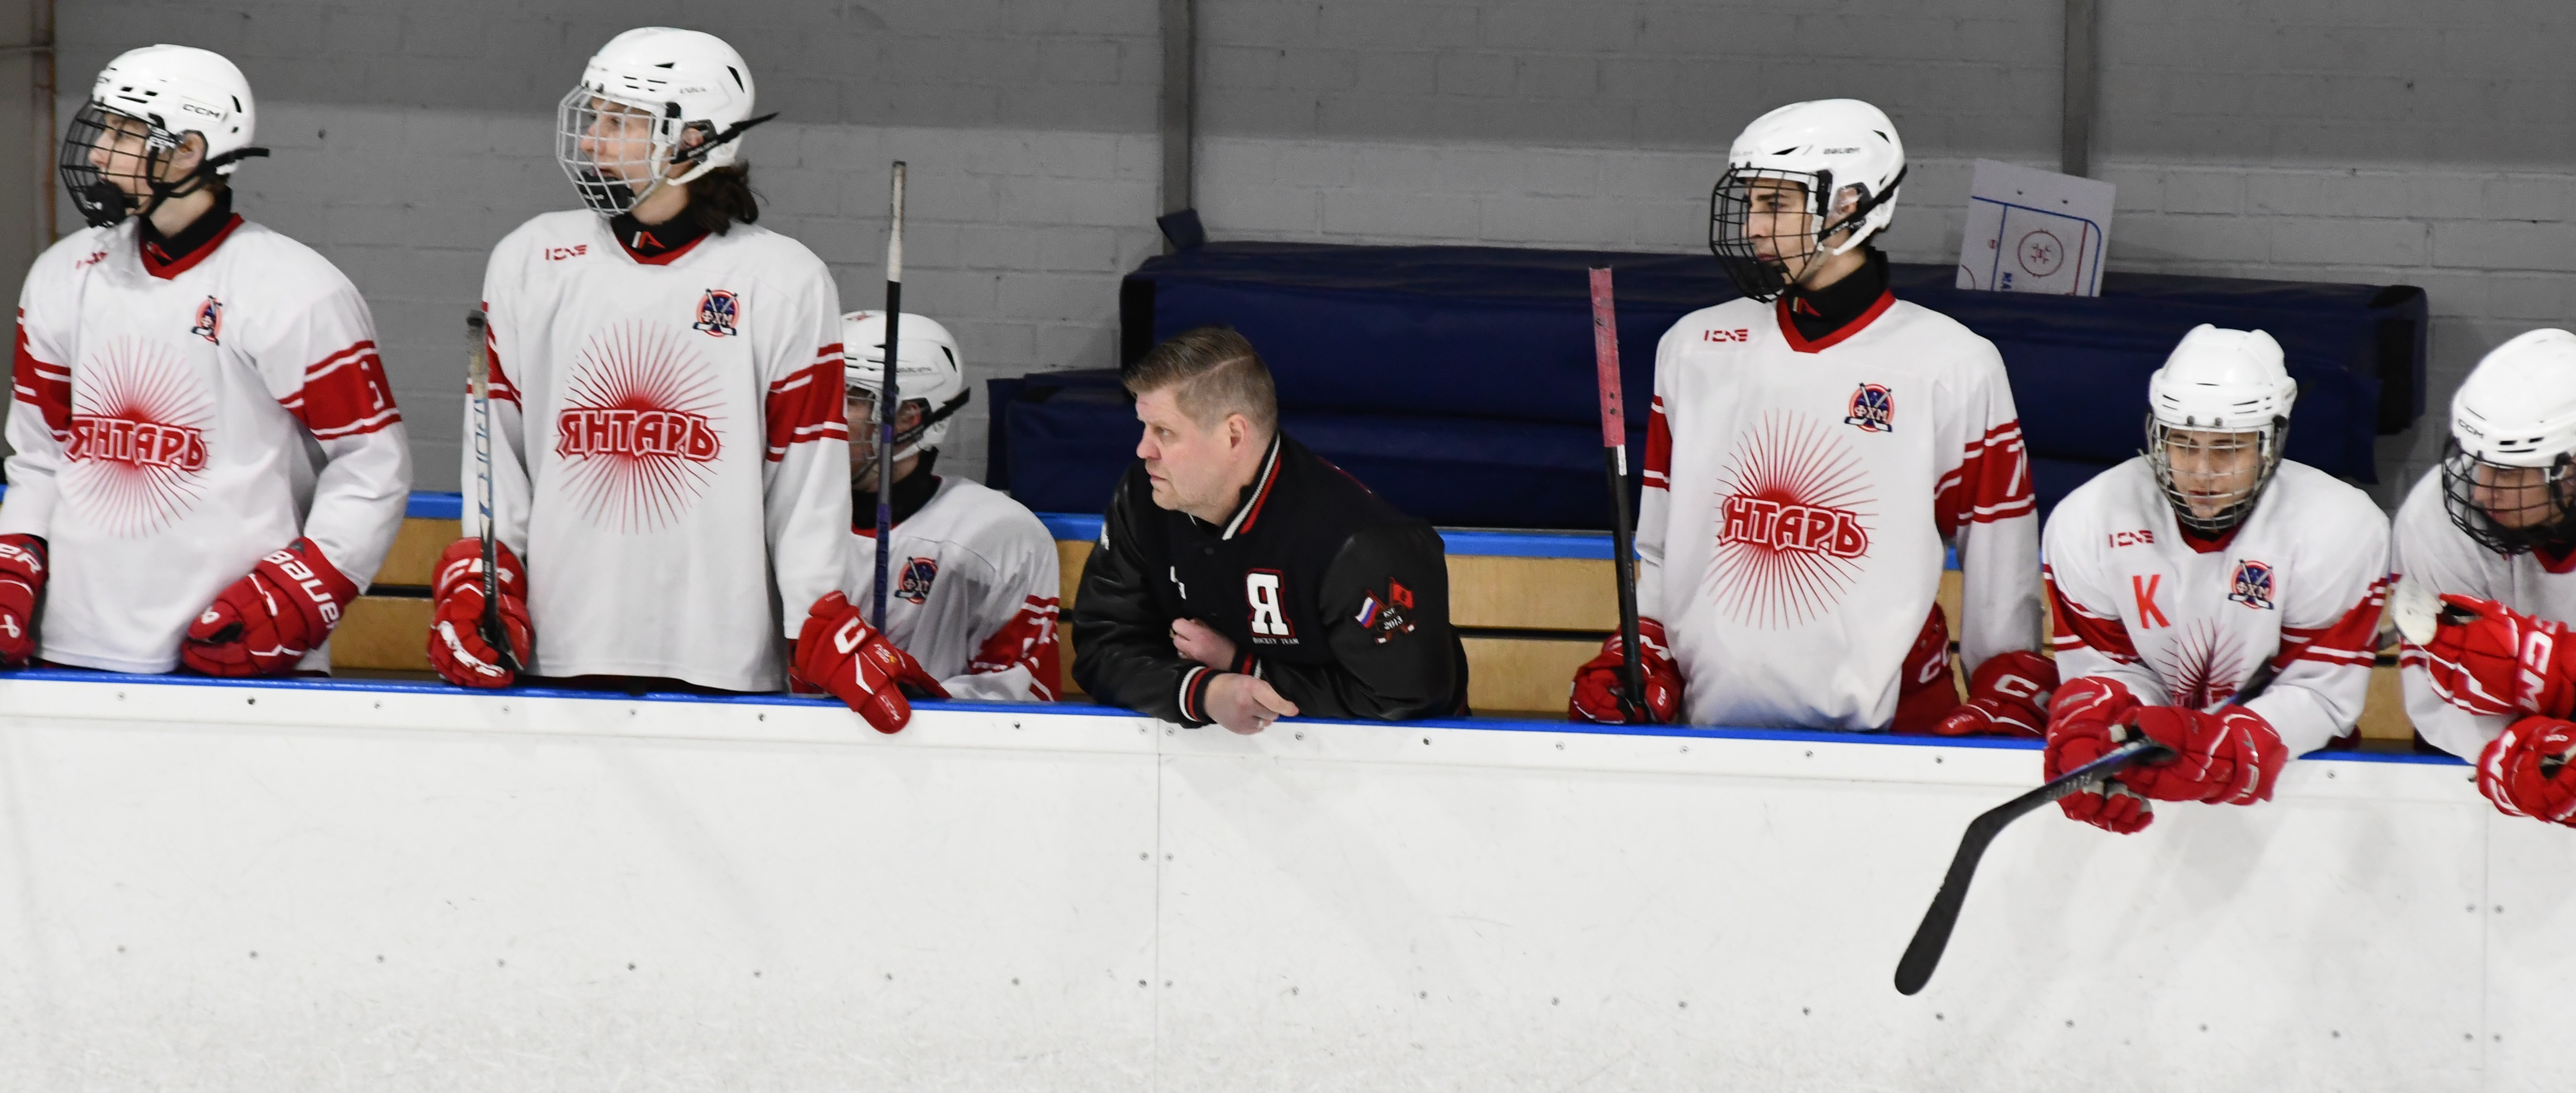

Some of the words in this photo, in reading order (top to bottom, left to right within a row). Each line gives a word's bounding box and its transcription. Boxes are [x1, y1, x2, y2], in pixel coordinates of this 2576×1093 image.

[183, 104, 220, 118] CCM
[64, 414, 207, 472] ЯНТАРЬ
[554, 408, 720, 462] ЯНТАРЬ
[1717, 493, 1868, 558] НТАРЬ
